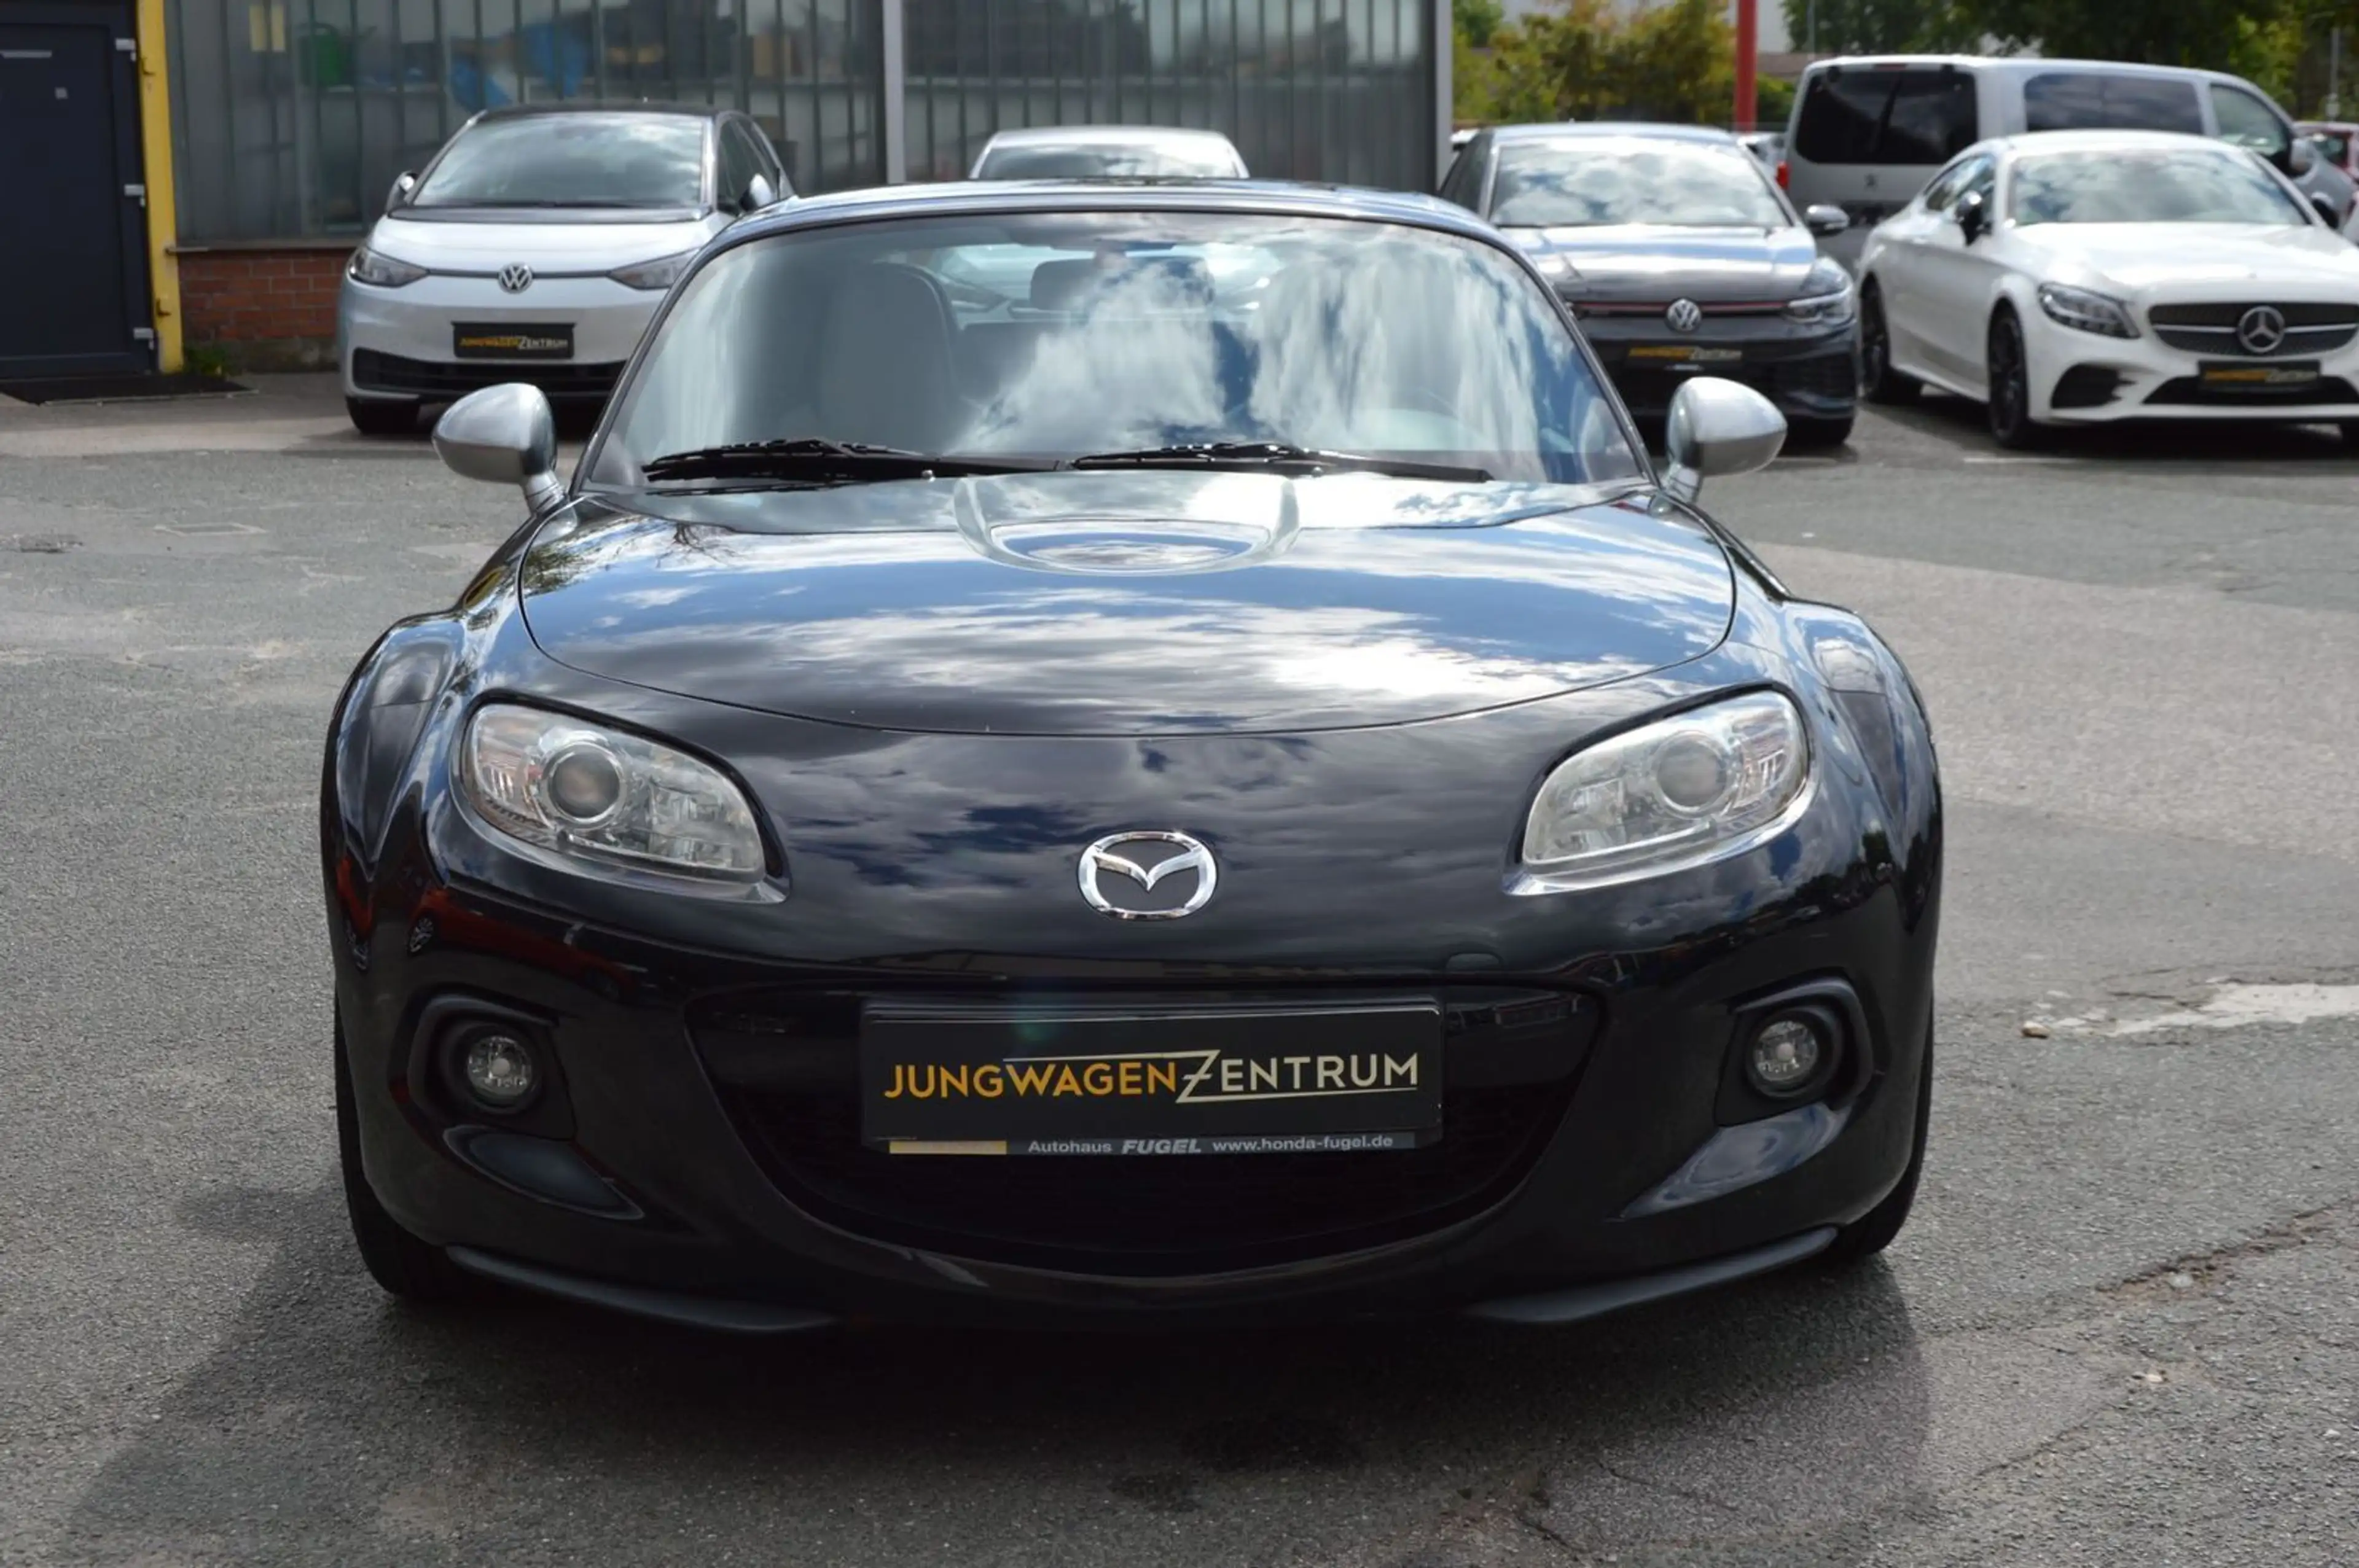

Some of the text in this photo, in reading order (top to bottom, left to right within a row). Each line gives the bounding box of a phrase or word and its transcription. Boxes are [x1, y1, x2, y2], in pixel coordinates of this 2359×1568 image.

[1028, 1134, 1393, 1155] Autohaus FUGEL www.honda-fugel.de
